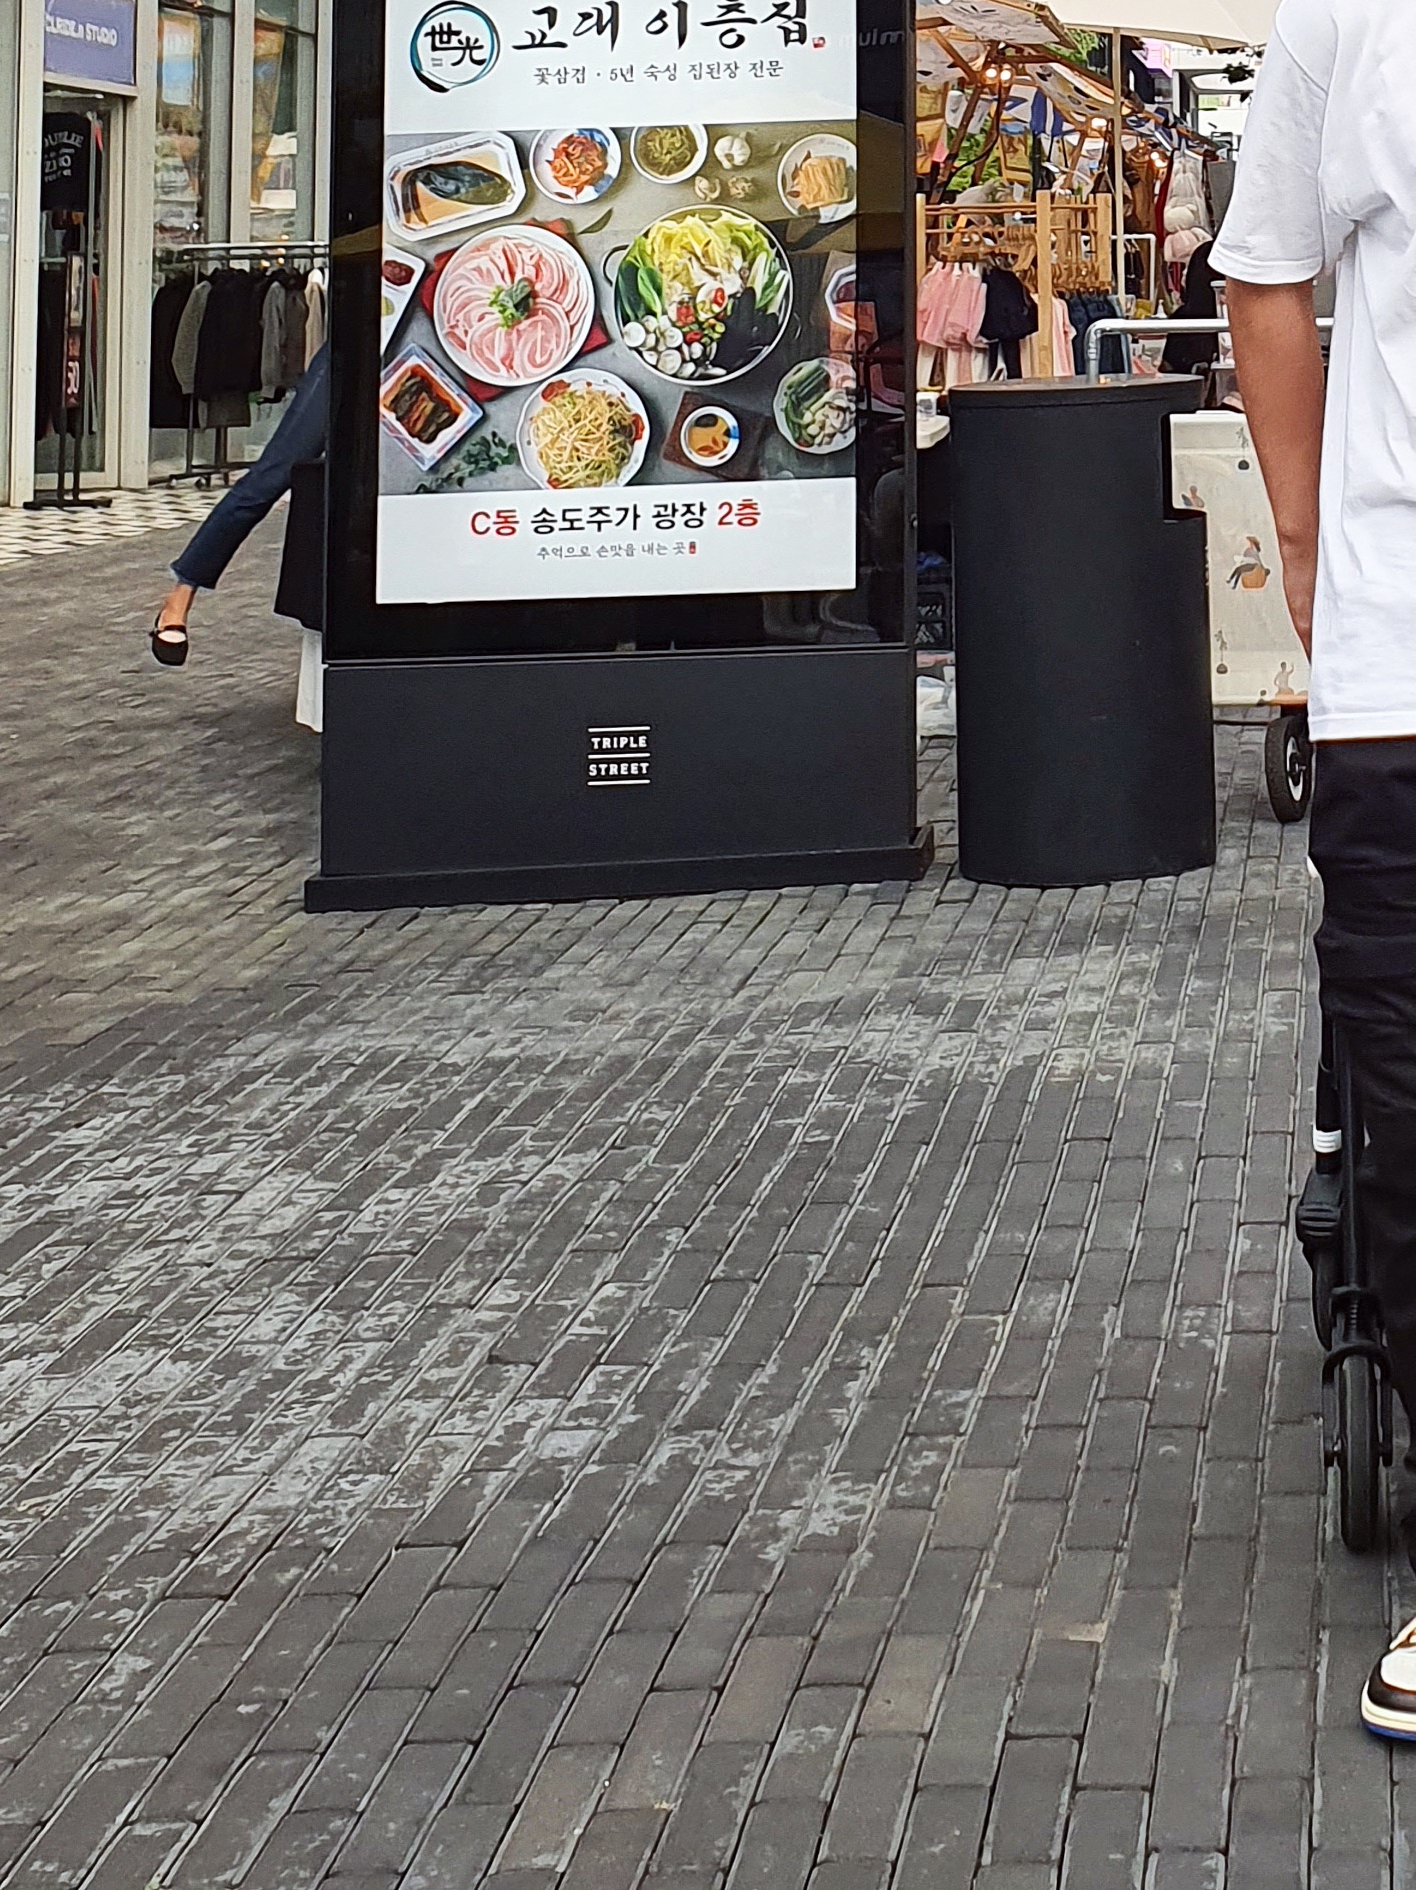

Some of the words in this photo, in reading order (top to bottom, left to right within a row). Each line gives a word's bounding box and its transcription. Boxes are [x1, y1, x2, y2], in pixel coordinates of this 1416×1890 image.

[511, 0, 620, 53] 교대
[609, 64, 635, 83] 5년
[643, 62, 678, 82] 숙성
[748, 59, 785, 78] 전문
[470, 508, 520, 537] C동
[530, 503, 641, 535] 송도주가
[651, 501, 707, 530] 광장
[717, 498, 762, 527] 2층
[641, 540, 669, 556] 내는
[591, 735, 648, 750] TRIPLE
[588, 762, 650, 777] STREET
